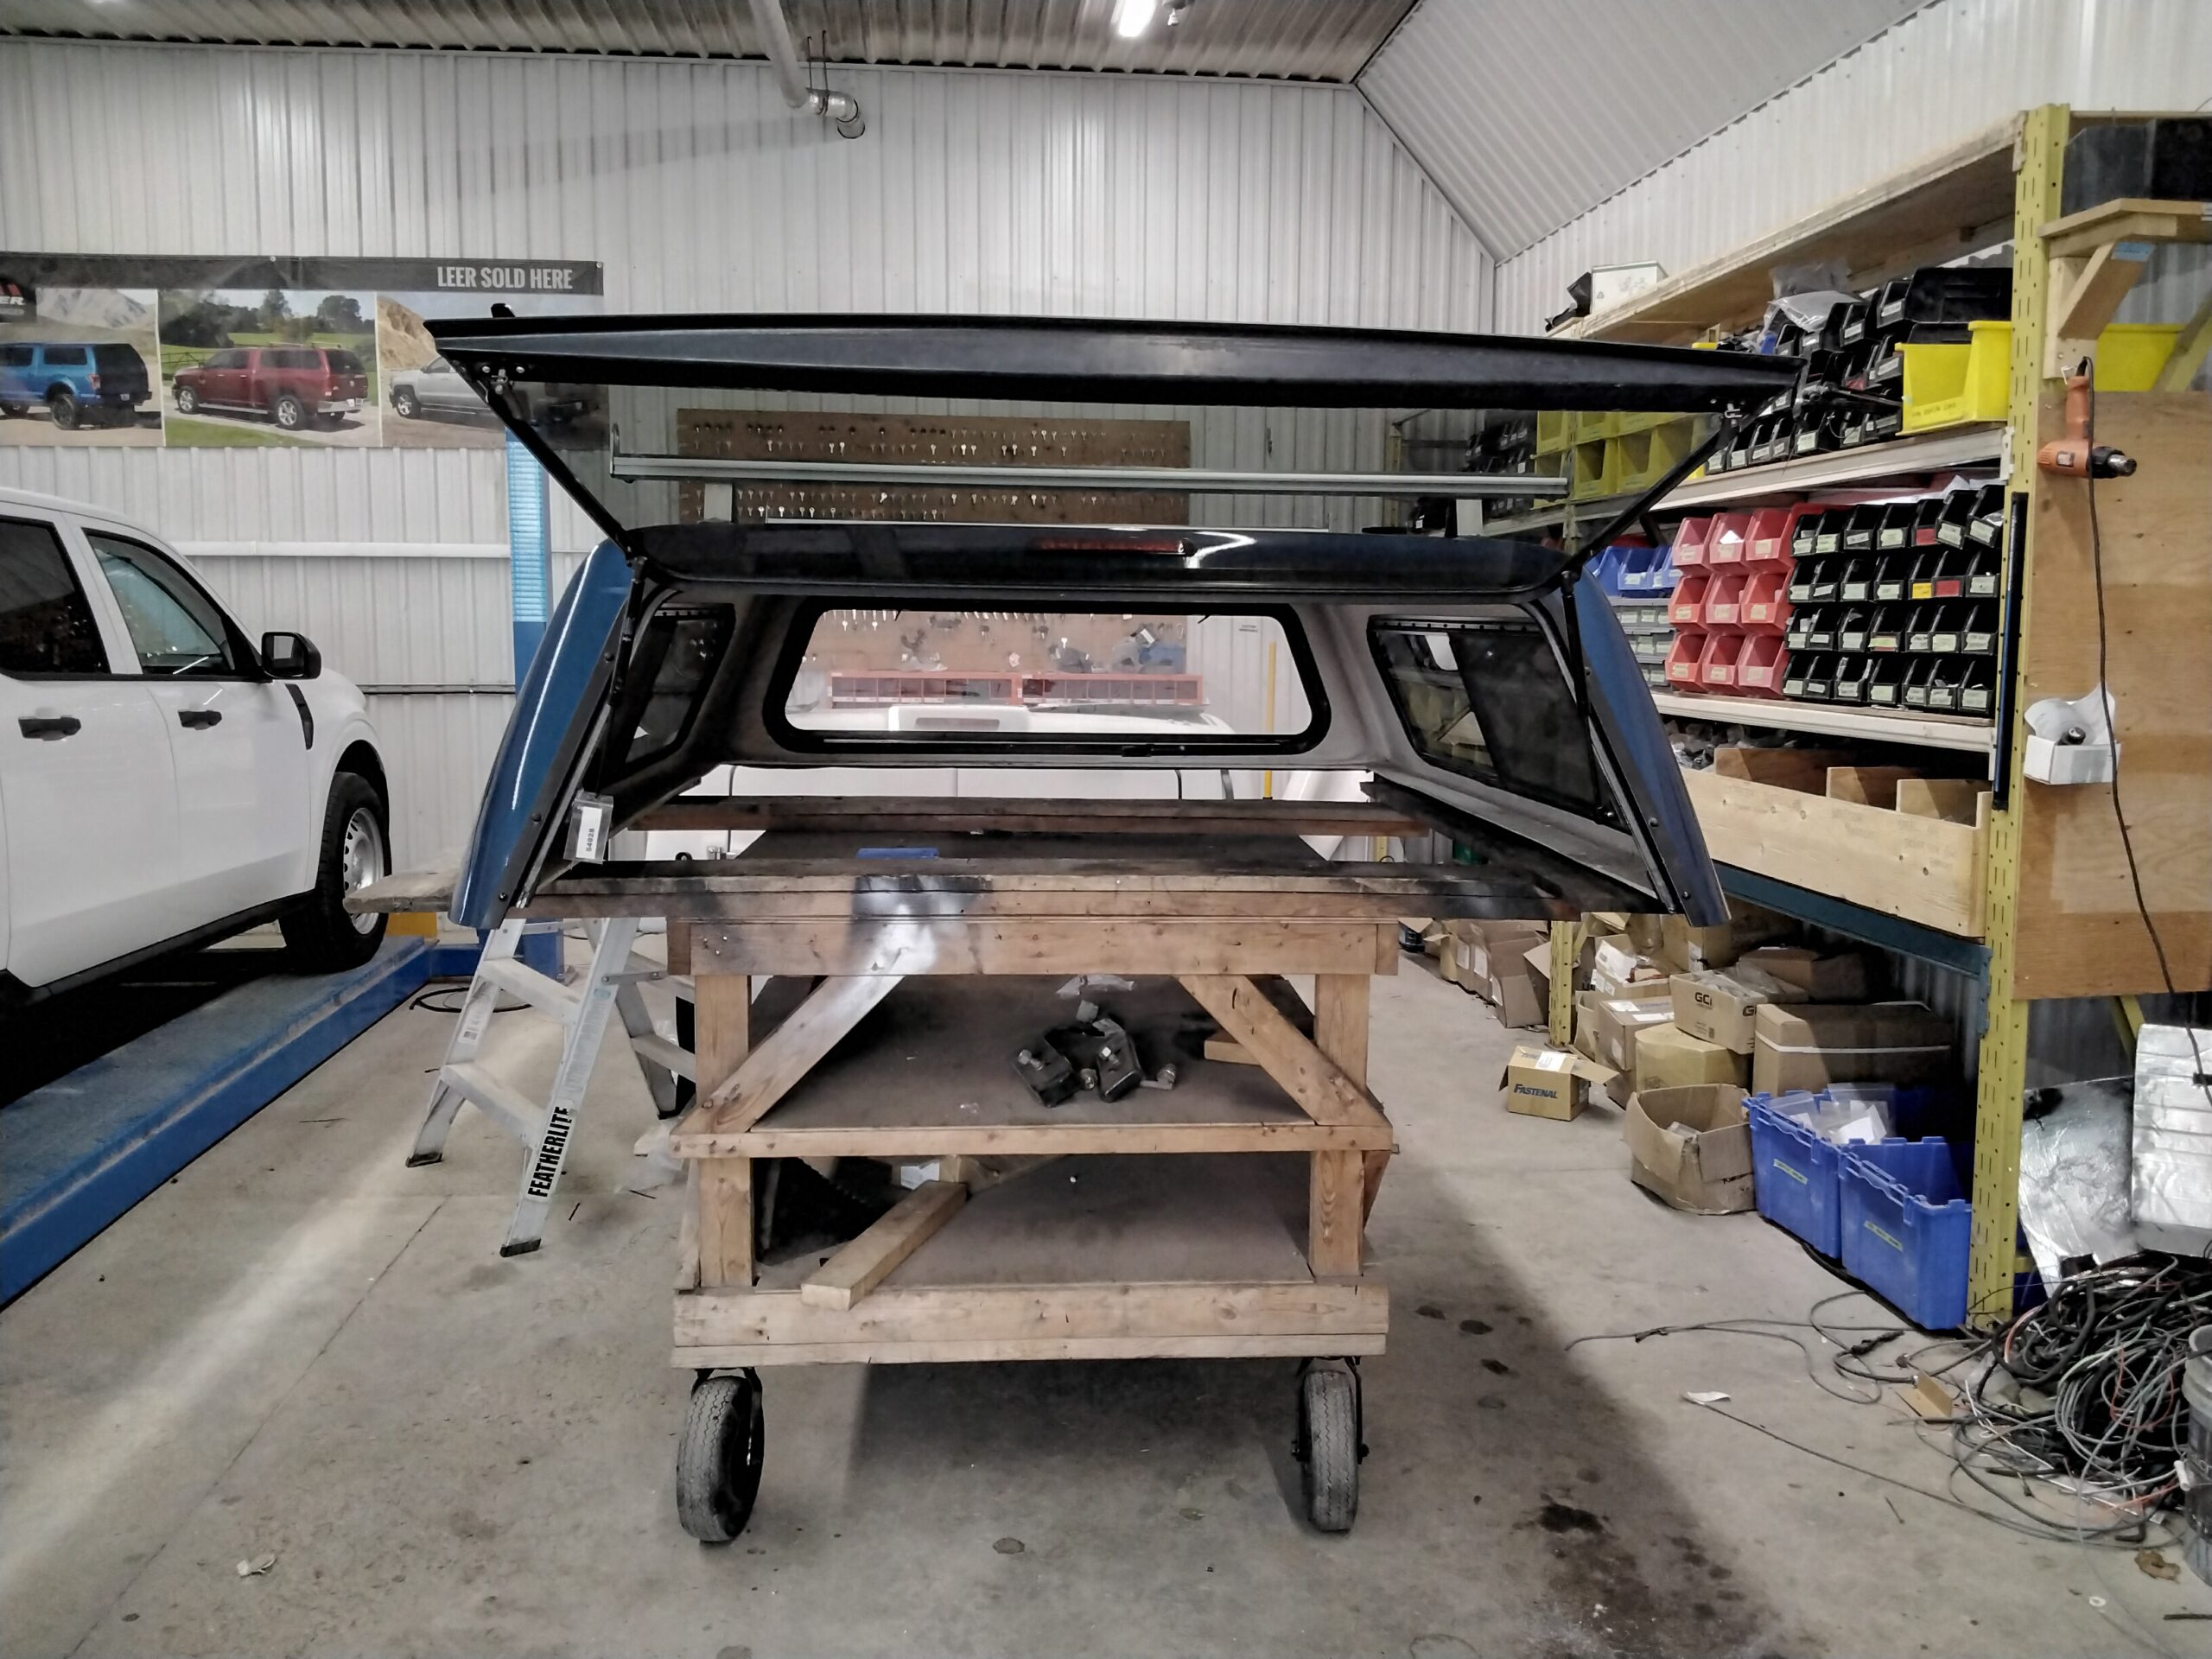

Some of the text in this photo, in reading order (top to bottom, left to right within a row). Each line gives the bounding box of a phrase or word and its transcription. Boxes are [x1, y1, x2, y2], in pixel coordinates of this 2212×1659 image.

[437, 266, 573, 289] LEER SOLD HERE
[0, 296, 25, 305] ER
